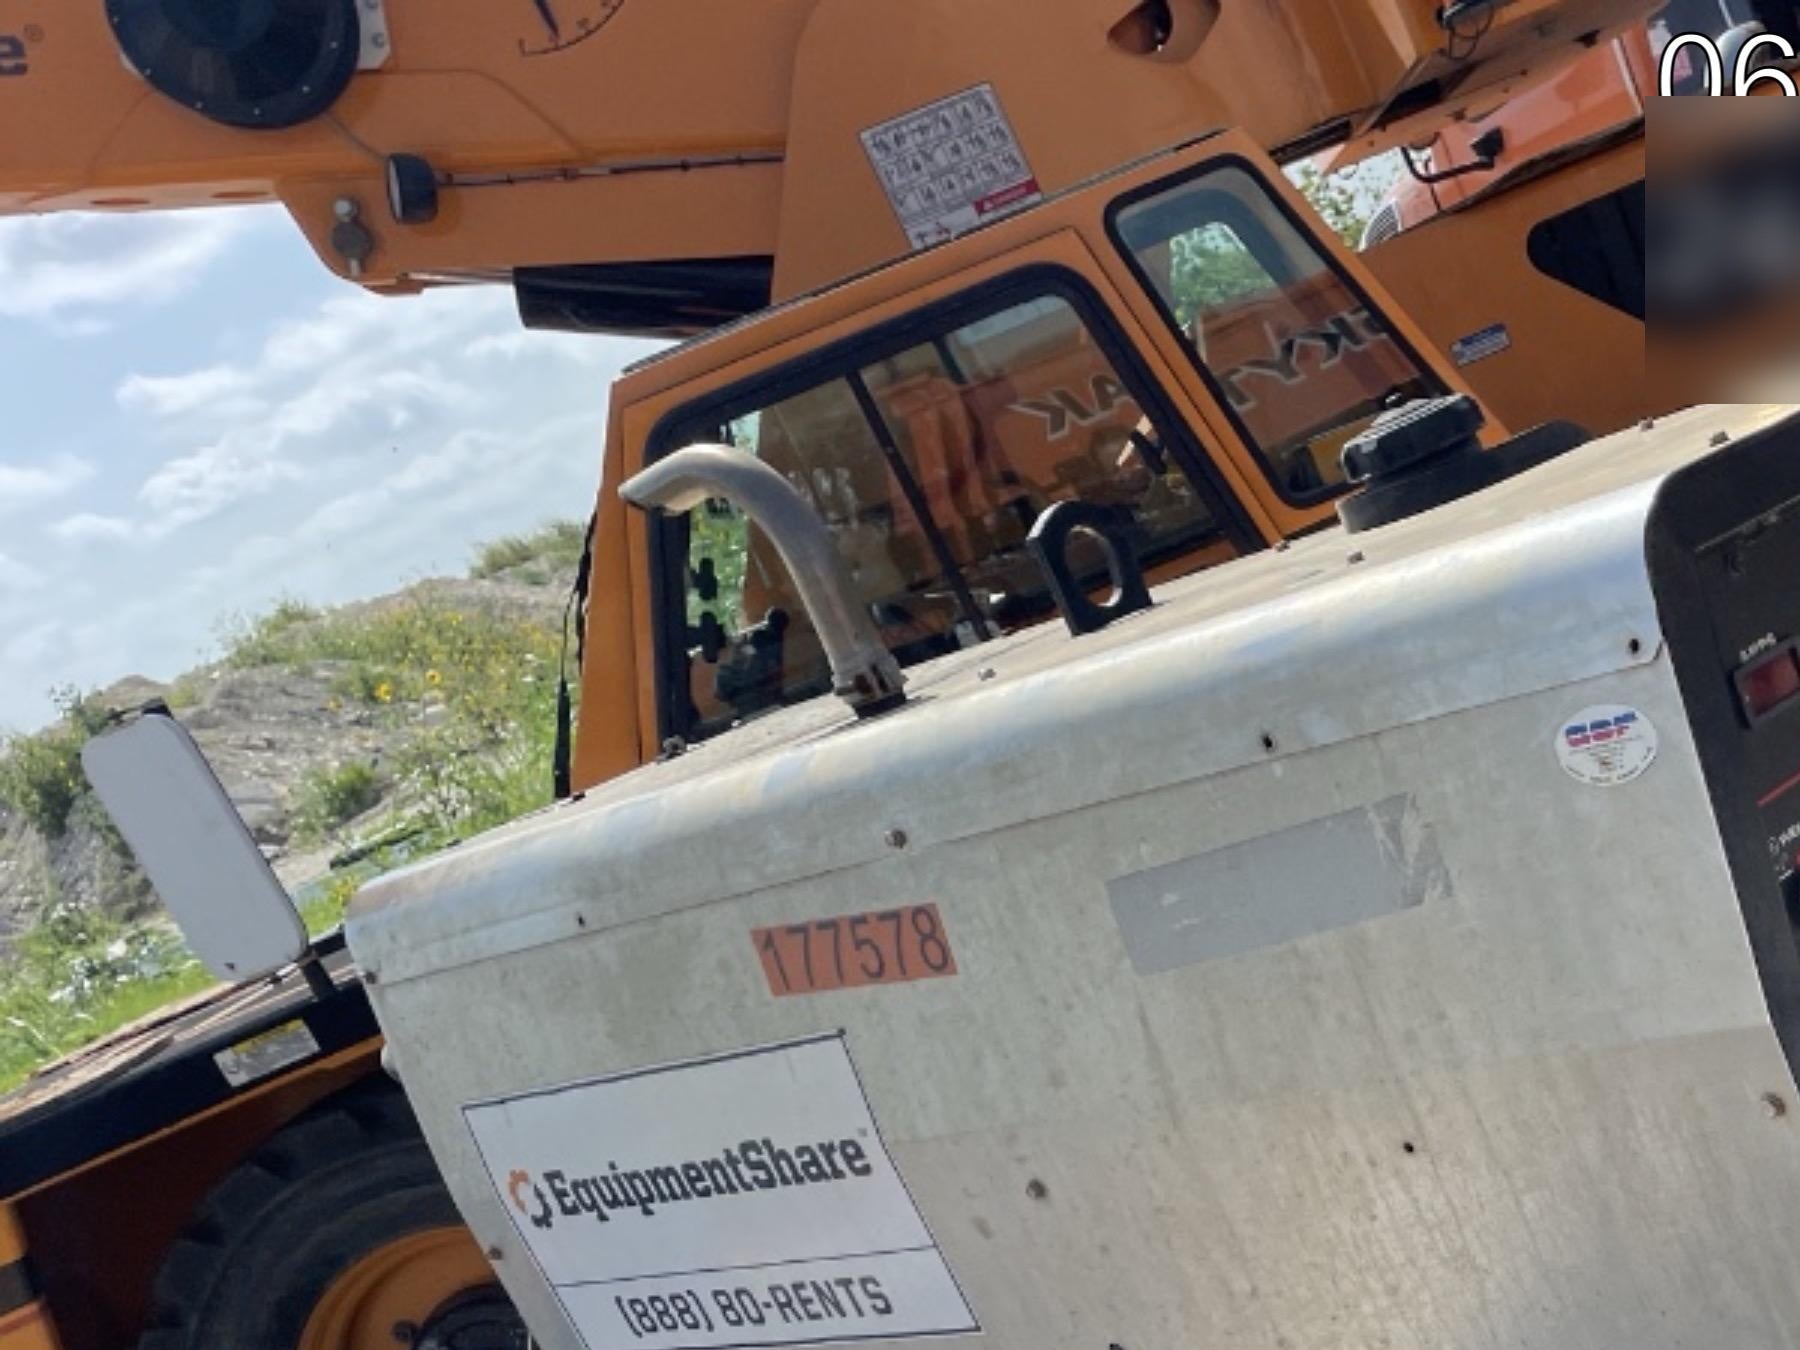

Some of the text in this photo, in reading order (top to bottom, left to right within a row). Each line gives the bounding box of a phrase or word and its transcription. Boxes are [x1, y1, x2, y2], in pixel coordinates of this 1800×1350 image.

[761, 906, 949, 991] 177578
[547, 1137, 873, 1221] EquipmentShare
[616, 1288, 714, 1337] (888)
